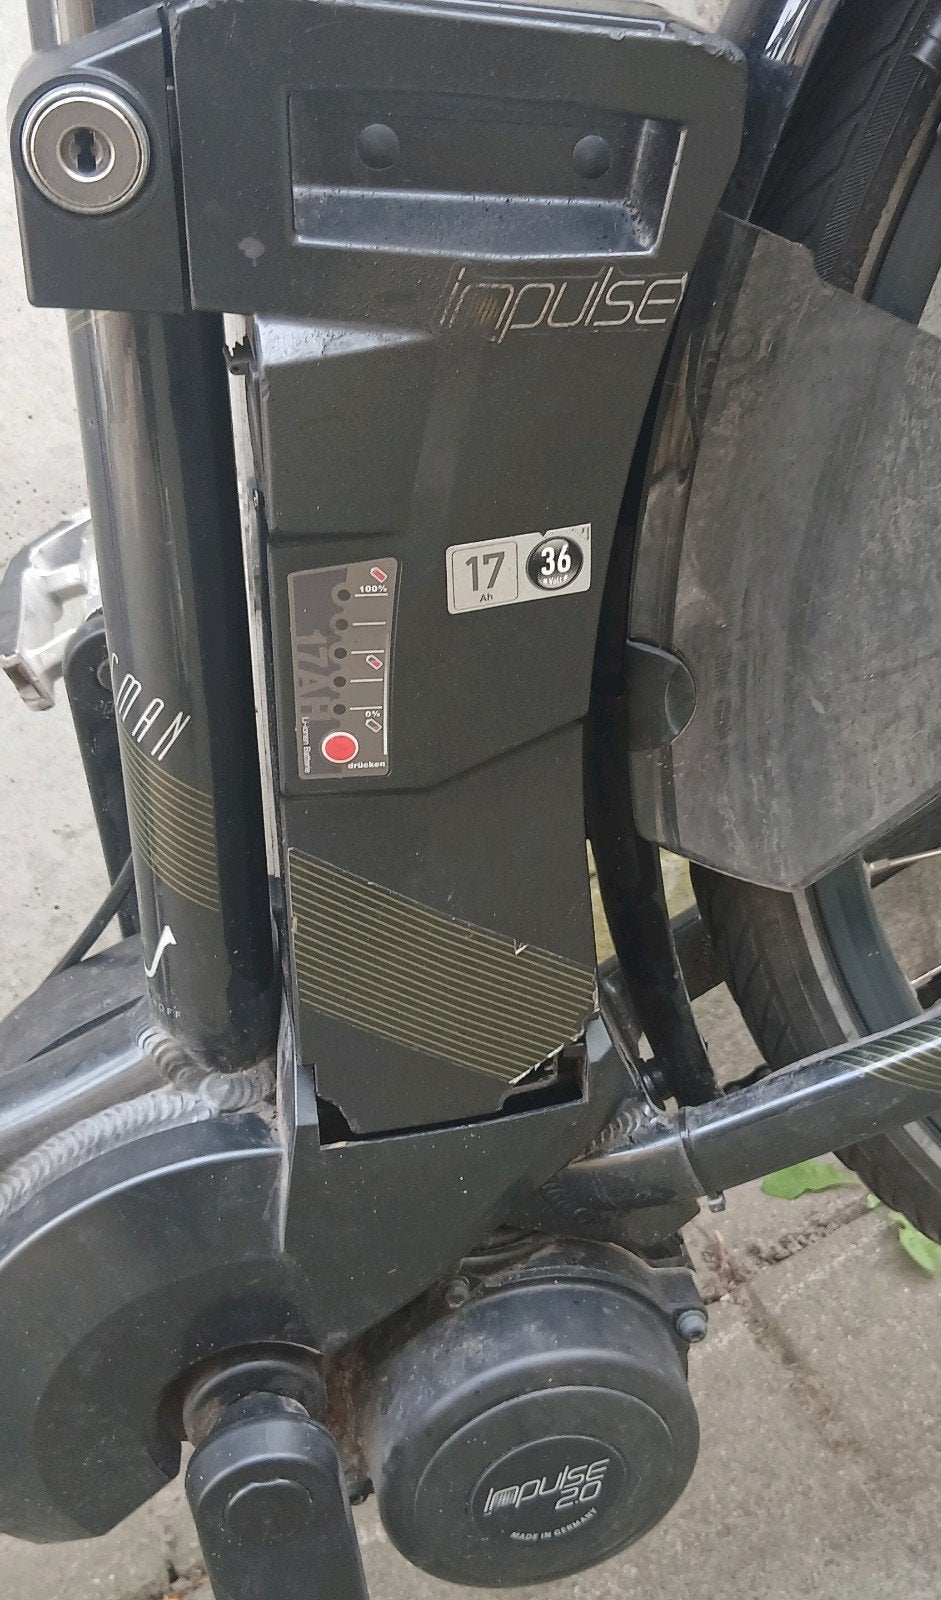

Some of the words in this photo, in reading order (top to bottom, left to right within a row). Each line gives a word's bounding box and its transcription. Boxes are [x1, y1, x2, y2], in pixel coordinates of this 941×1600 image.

[465, 551, 505, 591] 17
[540, 543, 571, 575] 36
[359, 584, 388, 593] 100%
[479, 592, 493, 602] Ah
[347, 761, 386, 769] drücken
[555, 1480, 602, 1510] 2.0
[510, 1531, 538, 1541] MADE
[540, 1531, 551, 1540] IN
[553, 1507, 598, 1536] GERMANY
